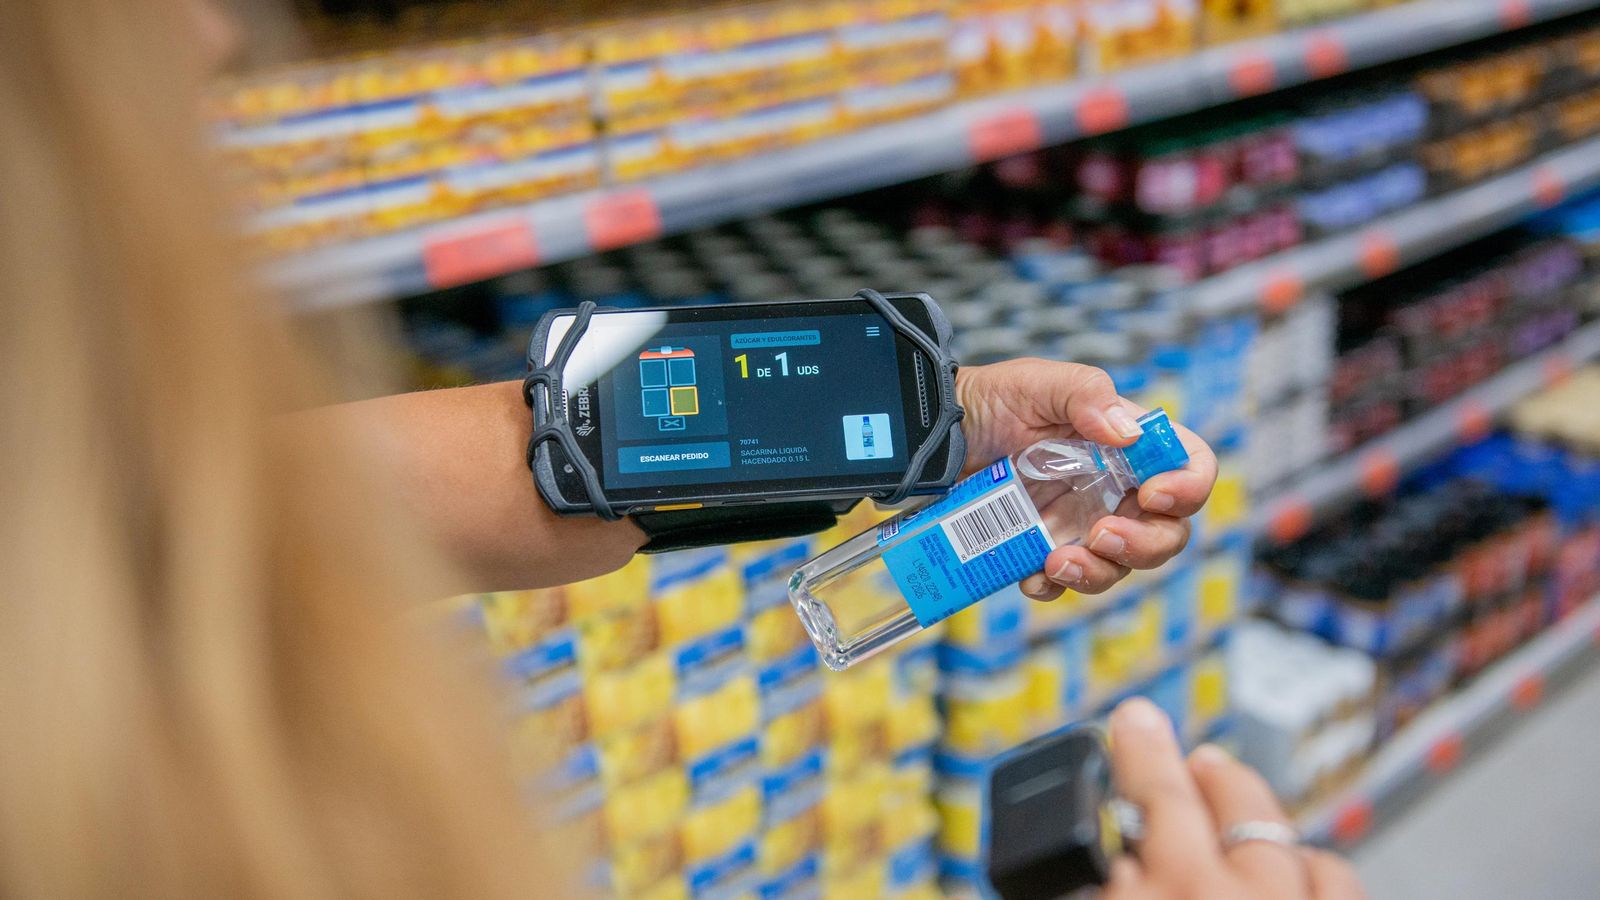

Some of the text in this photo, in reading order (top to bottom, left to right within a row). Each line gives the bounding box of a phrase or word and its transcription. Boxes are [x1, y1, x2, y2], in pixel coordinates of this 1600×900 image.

[735, 336, 760, 344] AZÚCAR
[767, 334, 817, 343] EDULCORANTES
[735, 352, 819, 378] 1 DE 1 UDS
[741, 448, 778, 456] SACARINA
[640, 452, 709, 463] ESCANEAR PEDIDO
[741, 456, 787, 465] HACENDADO
